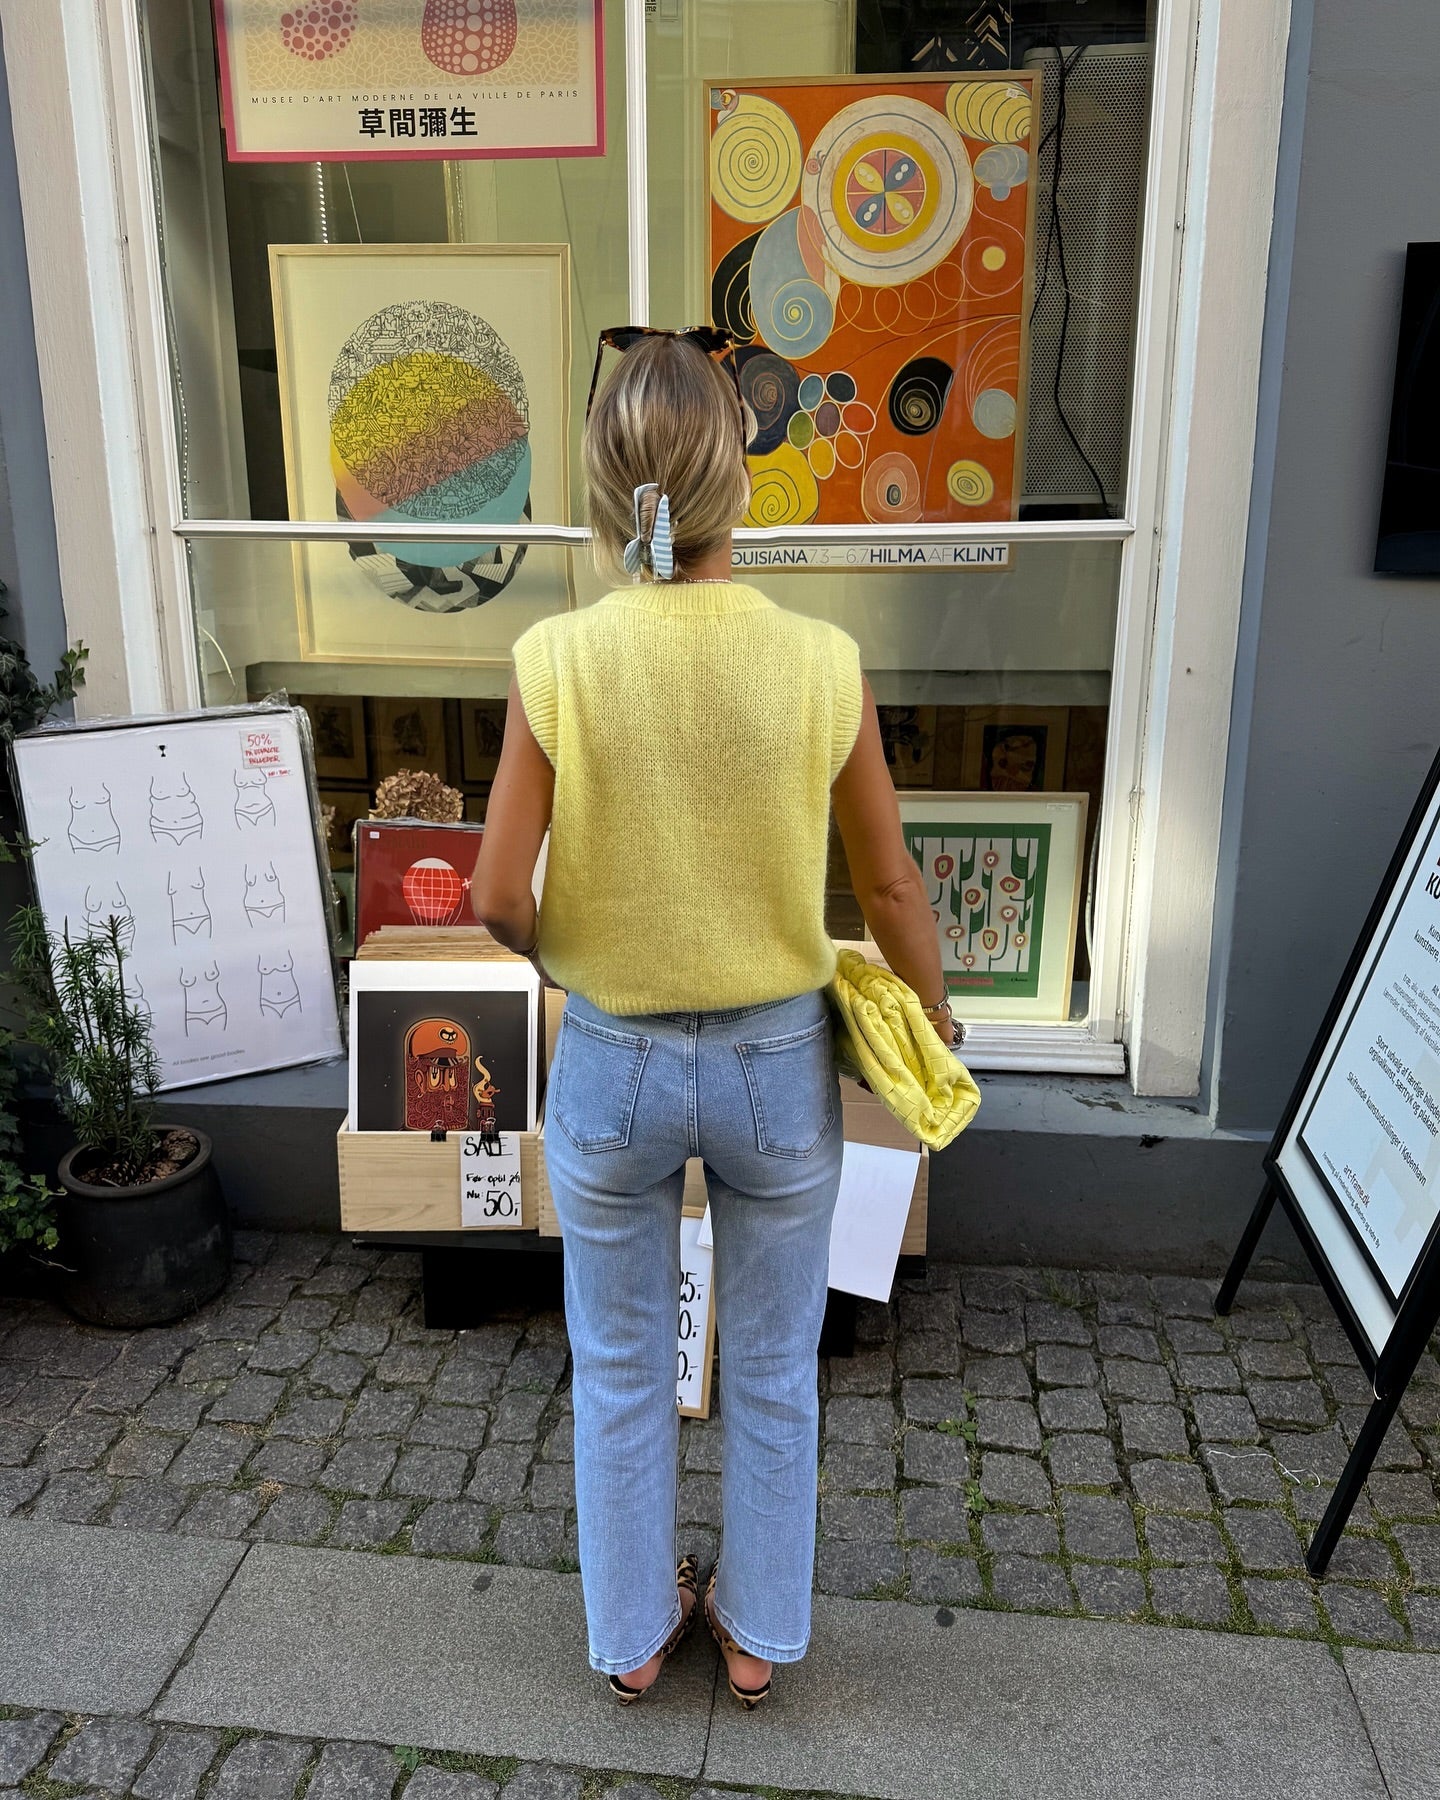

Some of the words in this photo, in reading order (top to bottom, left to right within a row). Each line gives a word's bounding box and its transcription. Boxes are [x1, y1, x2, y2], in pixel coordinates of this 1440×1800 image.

[251, 96, 294, 104] MUSEE
[303, 95, 342, 103] D'ART
[351, 94, 415, 102] MODERNE
[540, 90, 578, 98] PARIS
[358, 106, 478, 138] 草間彌生
[870, 548, 926, 563] HILMA
[927, 547, 953, 563] AF
[953, 547, 1006, 562] KLINT
[247, 733, 272, 747] 50%
[1414, 929, 1439, 962] kunstnere,
[1376, 1035, 1388, 1054] Stort
[1387, 1049, 1403, 1073] udvalg
[1401, 1066, 1409, 1077] af
[1406, 1071, 1425, 1099] færdige
[1395, 1079, 1414, 1105] særtryk
[1412, 1101, 1420, 1115] og
[1417, 1109, 1439, 1137] plakater
[1347, 1071, 1367, 1102] Skiftende
[1366, 1096, 1401, 1148] kunstudstillinger
[1401, 1145, 1427, 1186] København
[464, 1136, 513, 1157] SALE
[1343, 1164, 1370, 1208] art-frame.dk
